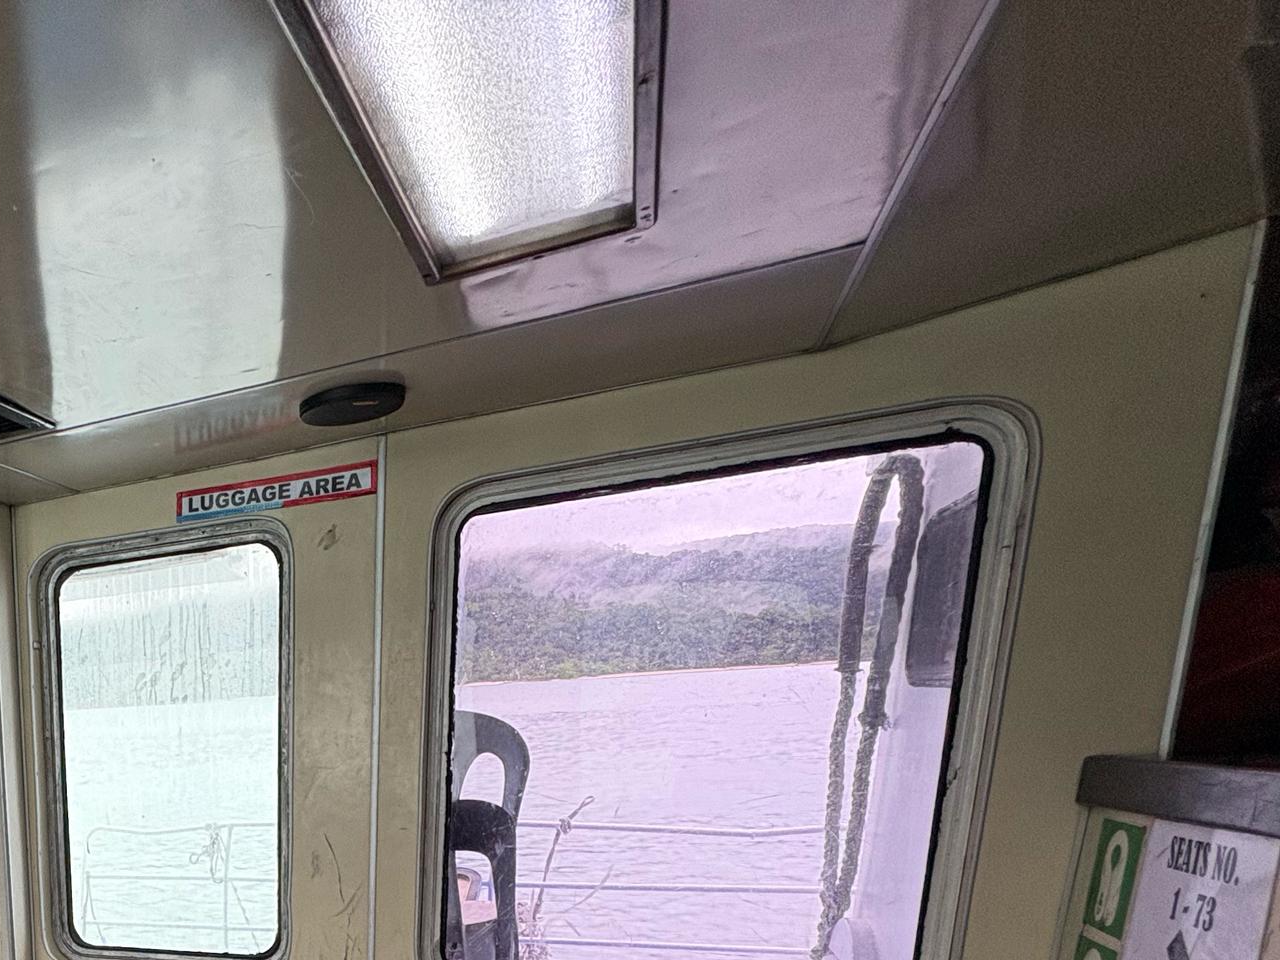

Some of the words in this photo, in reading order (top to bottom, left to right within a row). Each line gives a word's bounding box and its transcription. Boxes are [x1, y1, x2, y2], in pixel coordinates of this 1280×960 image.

[188, 482, 291, 513] LUGGAGE
[299, 472, 362, 498] AREA
[1167, 835, 1211, 877] SEATS
[1212, 845, 1239, 886] NO.
[1193, 894, 1217, 932] 73
